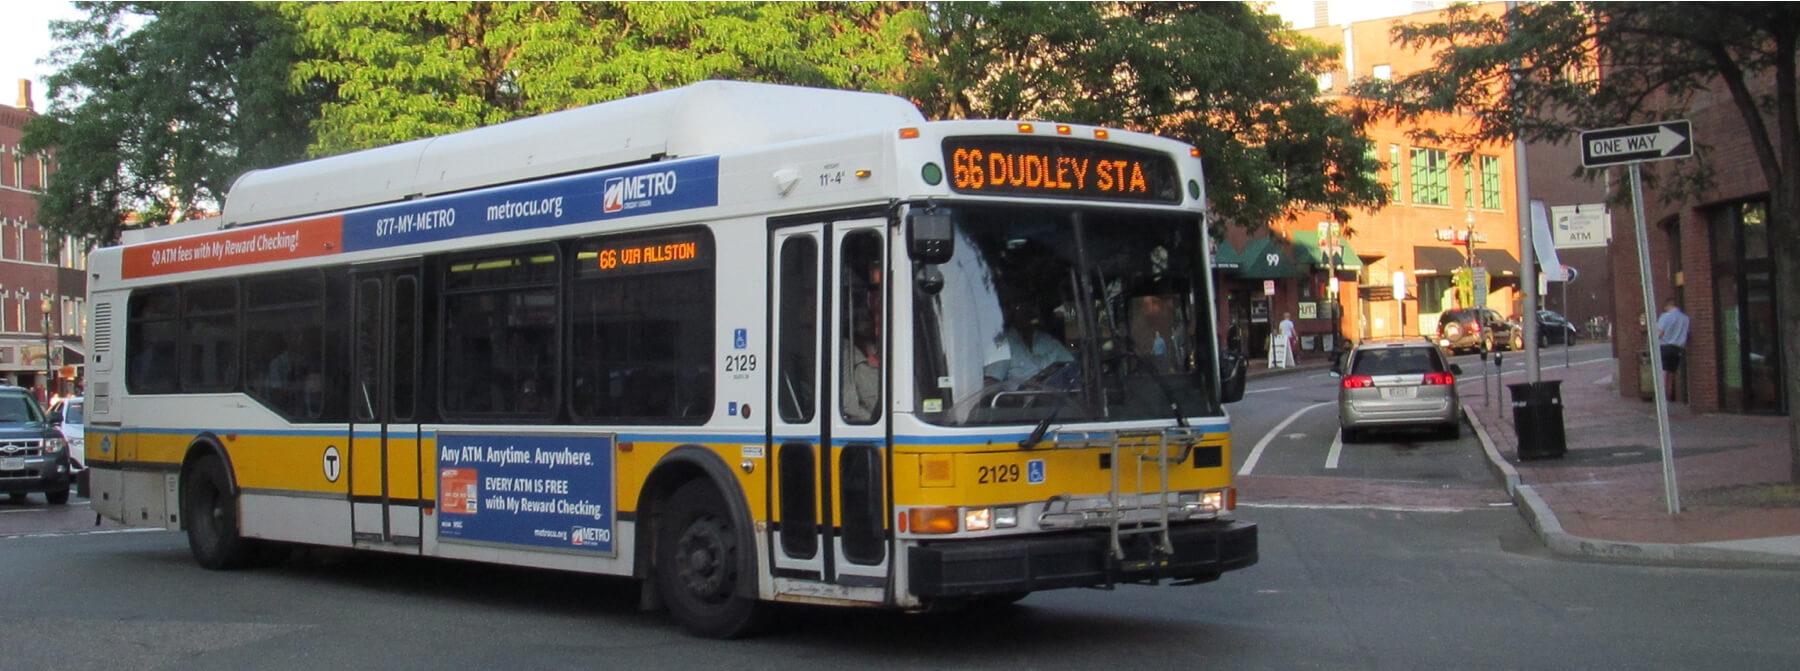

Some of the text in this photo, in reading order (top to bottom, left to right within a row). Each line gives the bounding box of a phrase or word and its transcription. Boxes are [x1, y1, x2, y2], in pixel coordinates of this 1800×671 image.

[1593, 135, 1657, 154] ONE WAY
[952, 148, 1147, 193] 66 DUDLEY STA
[624, 170, 677, 200] METRO
[376, 196, 564, 237] 877-MY-METRO metrocu.org
[1569, 232, 1592, 240] ATM
[161, 247, 177, 264] ATM
[177, 246, 193, 262] fees
[194, 243, 211, 260] with
[212, 241, 224, 261] My
[224, 235, 256, 255] Reward
[256, 230, 300, 252] Checking!
[600, 242, 695, 269] 66 VIA ALLSTON
[1266, 253, 1280, 267] 99
[725, 354, 757, 372] 2129
[326, 456, 337, 476] T
[441, 445, 460, 466] Any
[487, 446, 533, 467] Anytime.
[535, 447, 594, 469] Anywhere.
[978, 464, 1020, 484] 2129
[485, 476, 568, 494] EVERY ATM IS FREE
[485, 495, 505, 510] with
[506, 497, 520, 514] My
[521, 498, 555, 513] Reward
[582, 527, 610, 542] METRO
